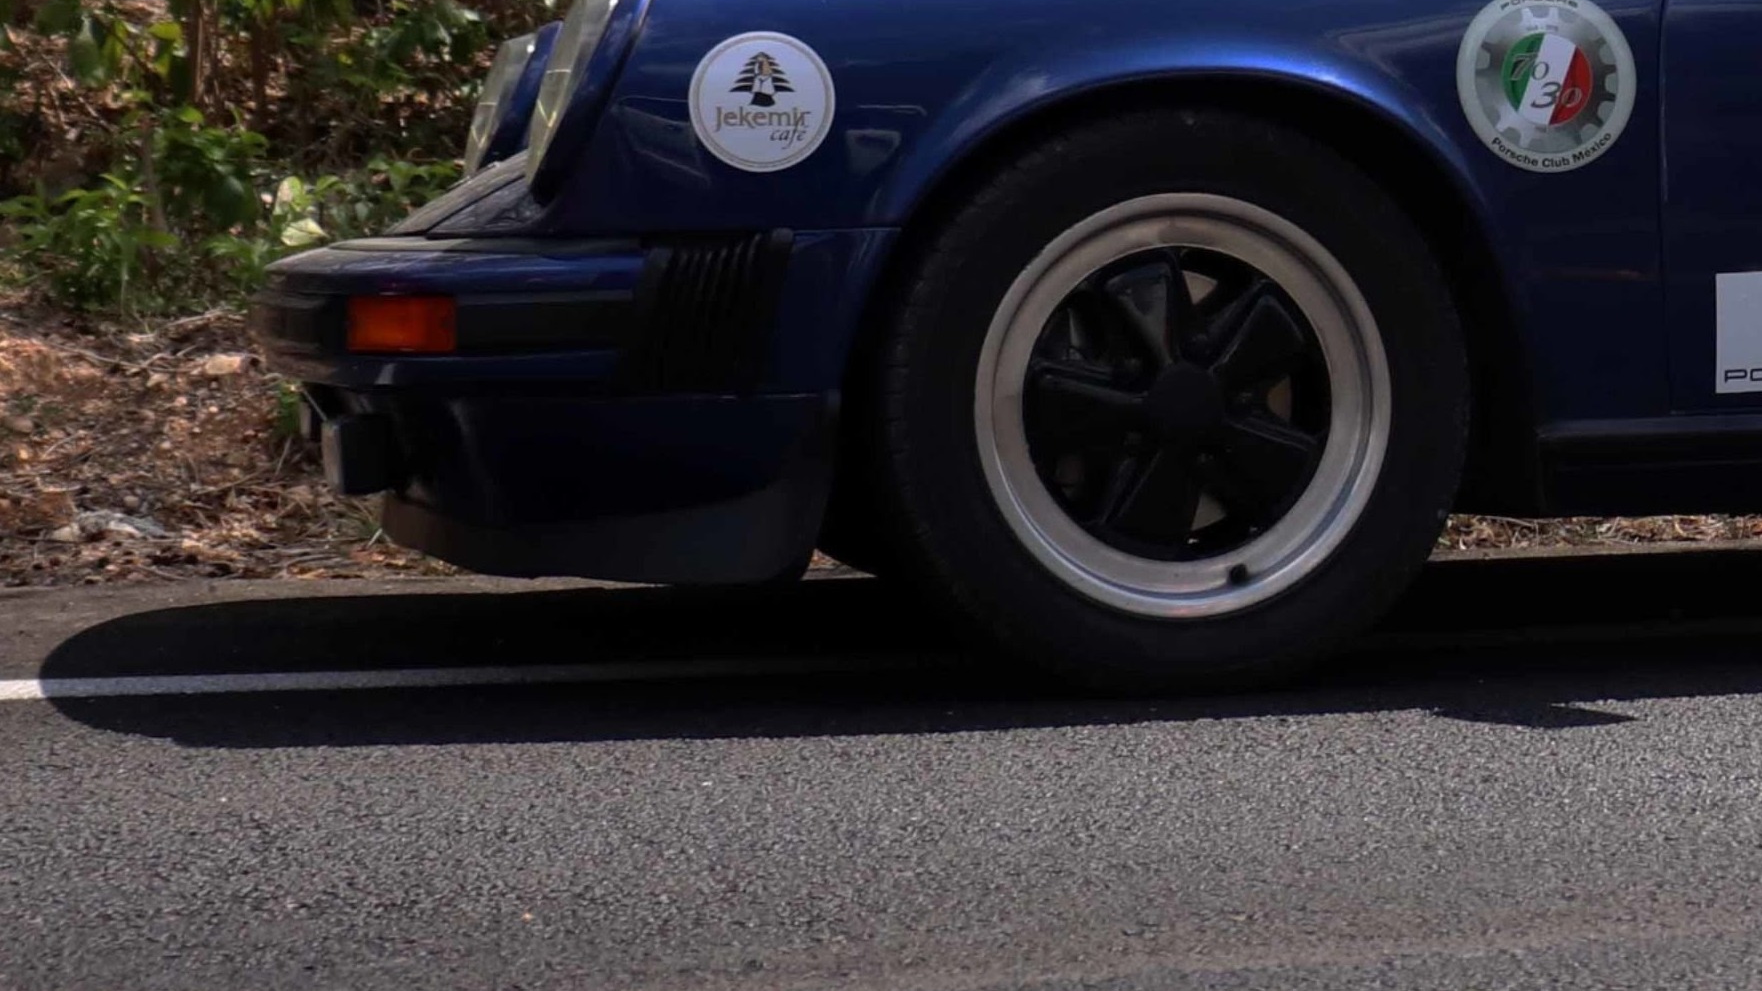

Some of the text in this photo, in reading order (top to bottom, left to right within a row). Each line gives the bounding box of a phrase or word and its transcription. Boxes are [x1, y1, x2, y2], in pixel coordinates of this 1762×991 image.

[715, 107, 811, 132] Jekemir
[1491, 136, 1539, 168] Porsche
[1541, 156, 1571, 169] Club
